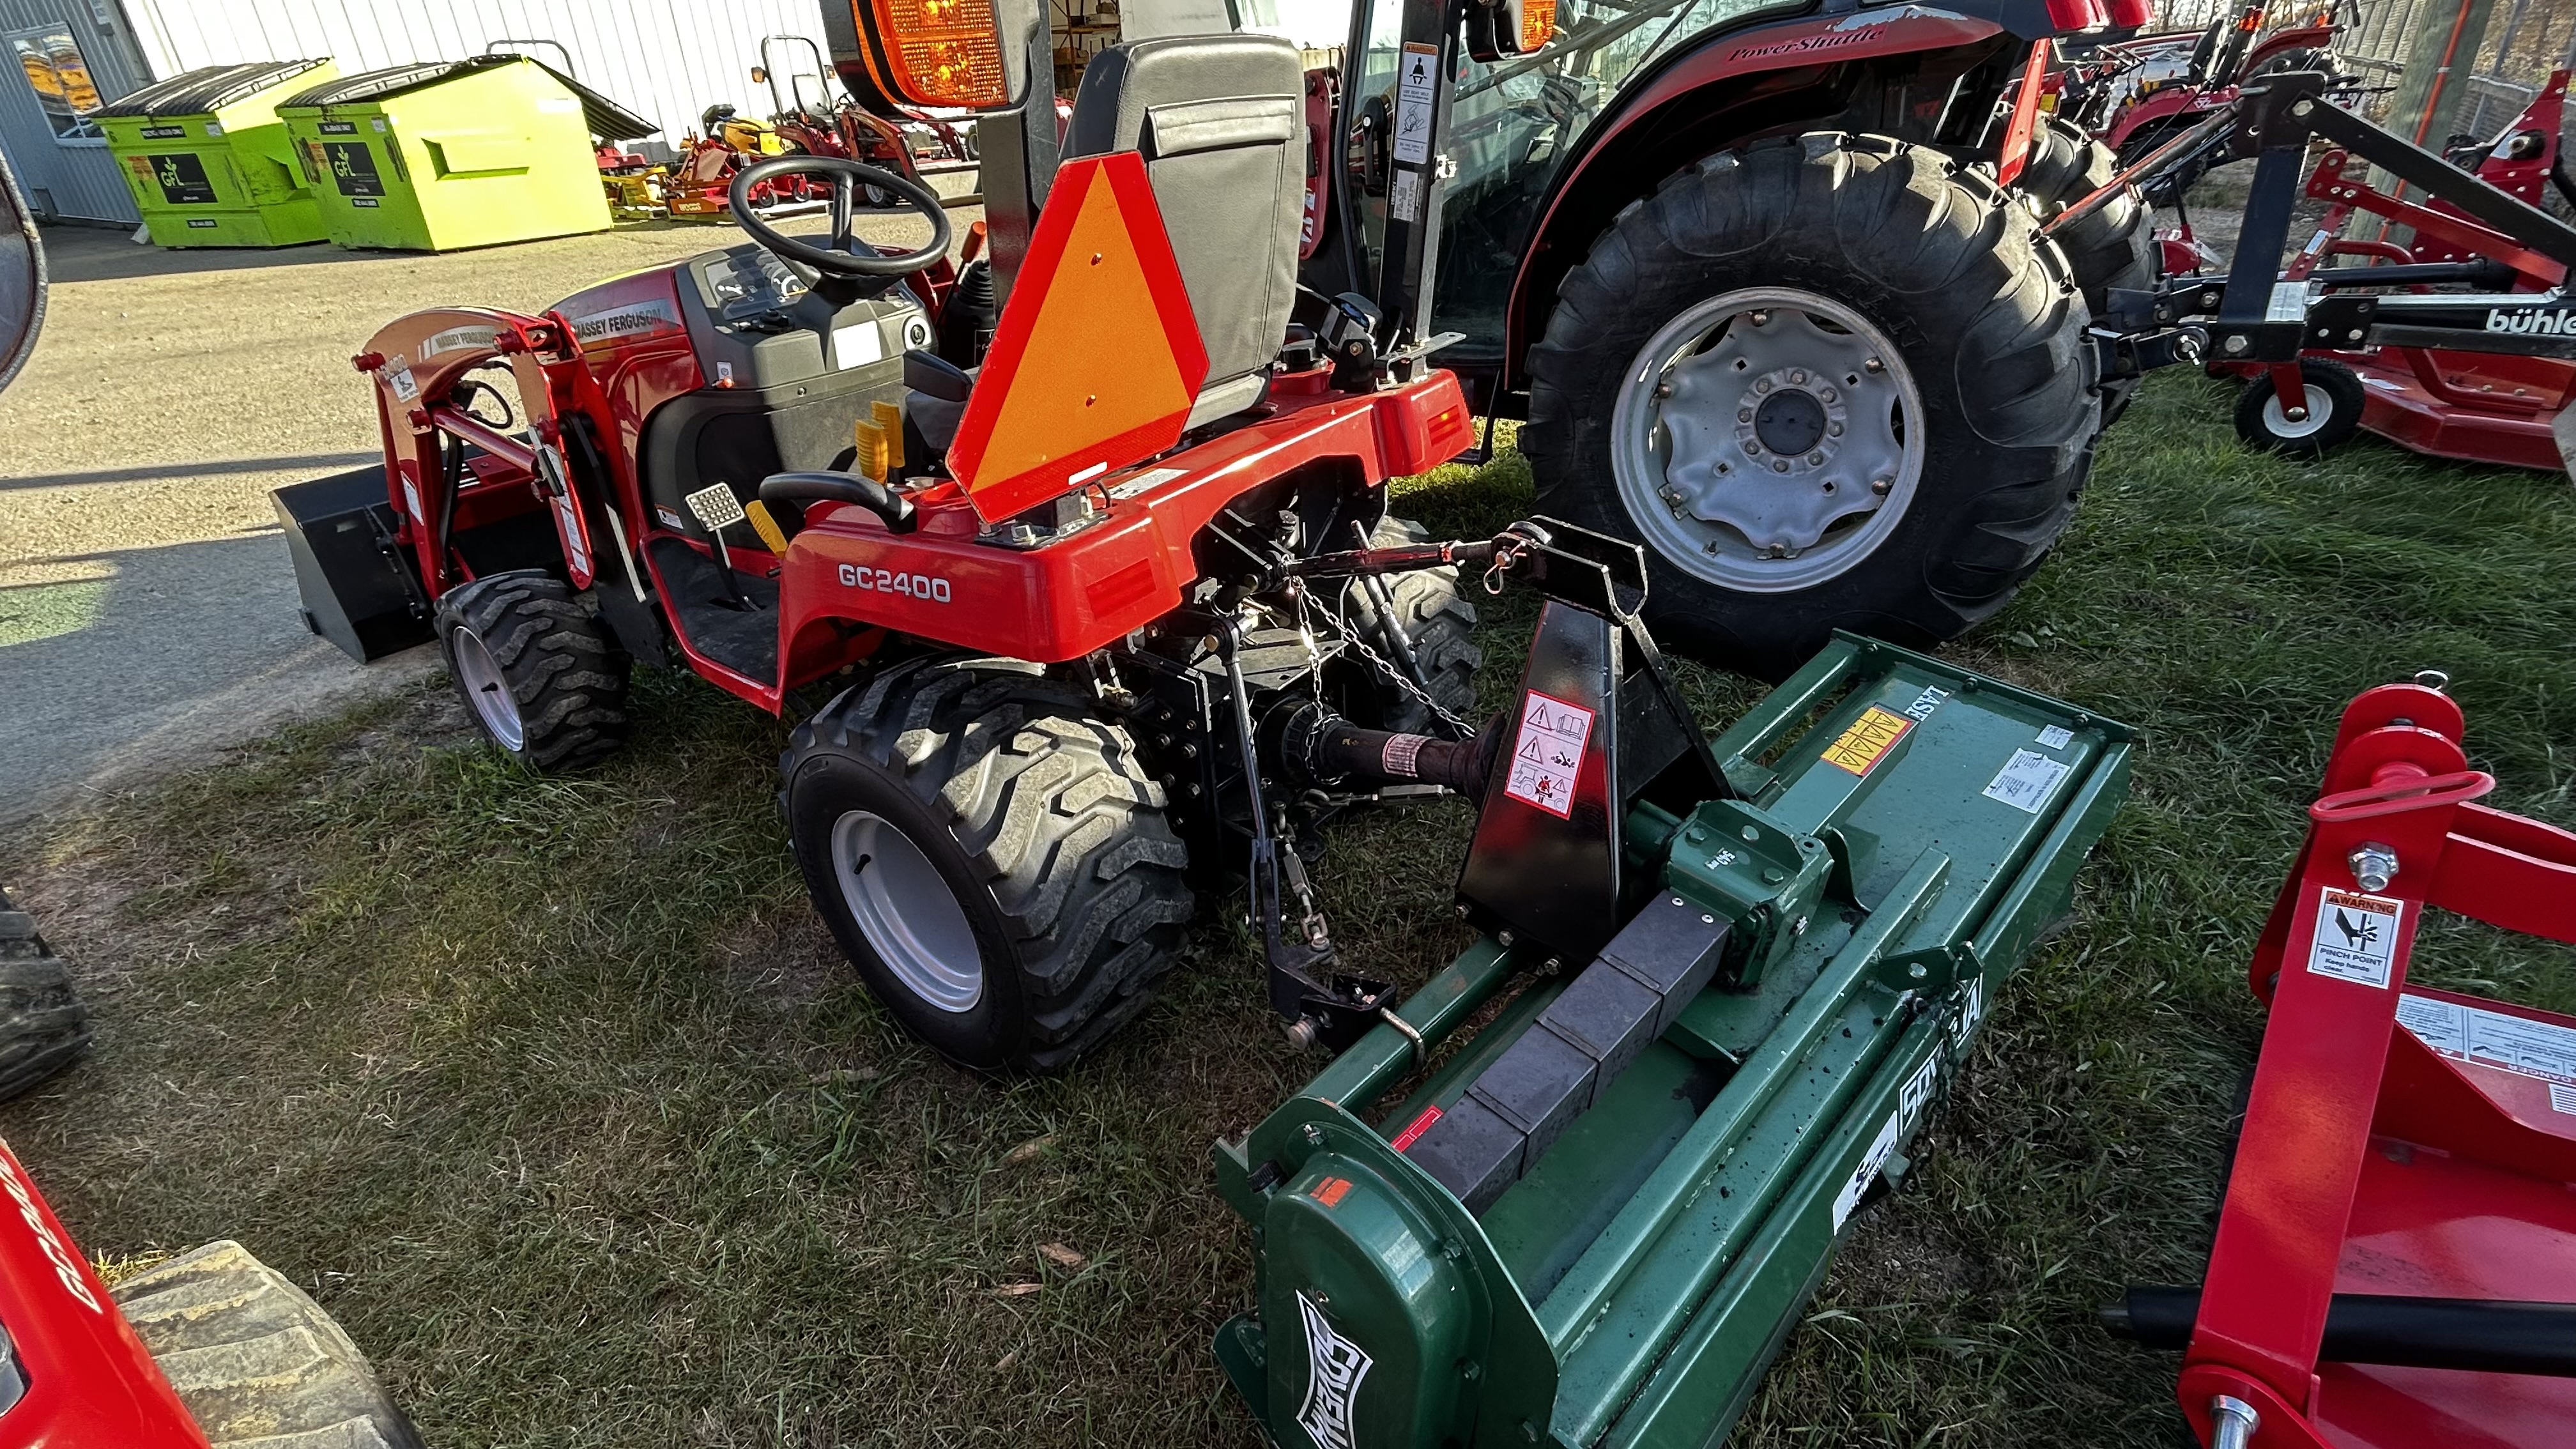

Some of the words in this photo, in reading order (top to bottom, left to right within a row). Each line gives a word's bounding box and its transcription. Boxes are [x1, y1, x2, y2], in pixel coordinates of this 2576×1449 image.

[1728, 29, 1884, 61] PowerShuttle
[334, 155, 356, 178] GFL
[160, 167, 185, 187] GFL
[574, 318, 607, 339] MASSEY
[608, 308, 663, 333] FERGUSON
[838, 564, 951, 603] GC2400
[2320, 947, 2350, 960] PINCH
[2352, 954, 2383, 966] POINT
[2324, 958, 2345, 967] Keep
[2346, 962, 2370, 972] hands
[2324, 965, 2344, 974] clear.
[2507, 1064, 2572, 1083] DANGER
